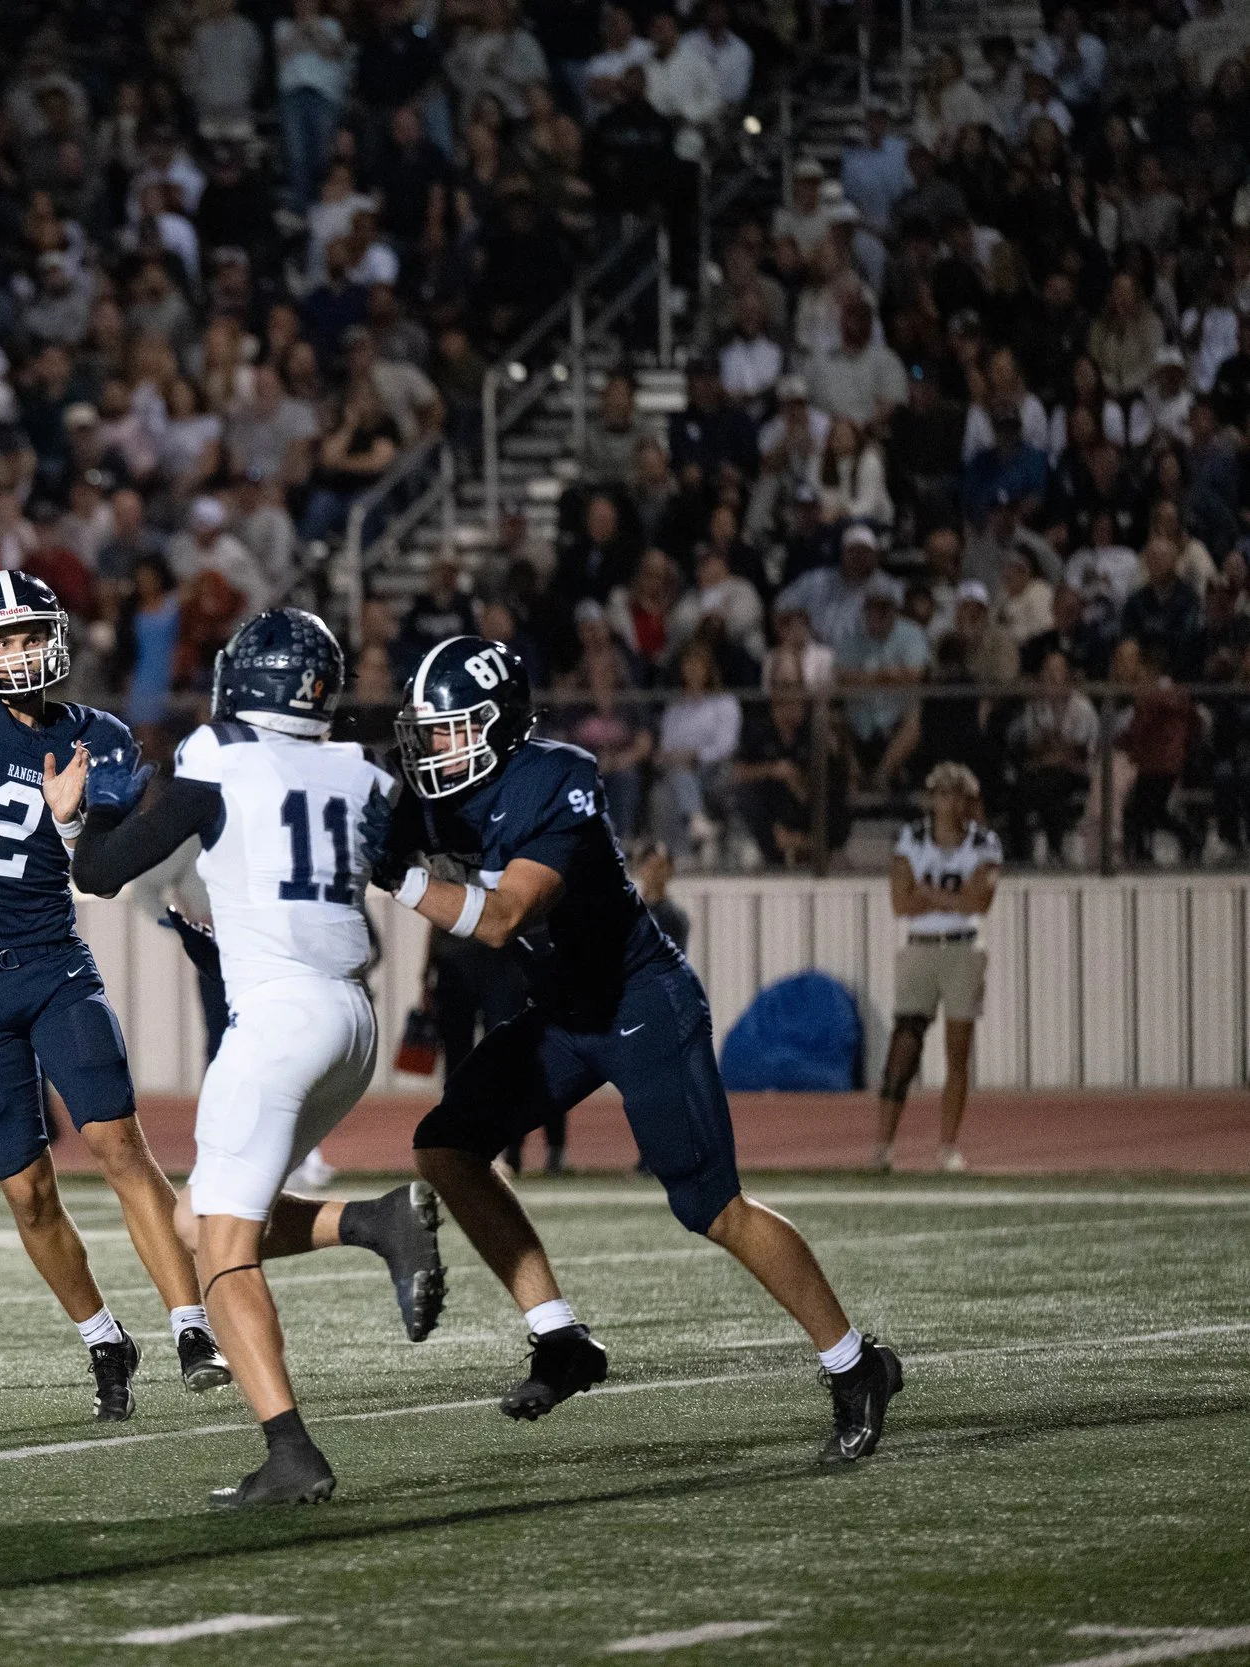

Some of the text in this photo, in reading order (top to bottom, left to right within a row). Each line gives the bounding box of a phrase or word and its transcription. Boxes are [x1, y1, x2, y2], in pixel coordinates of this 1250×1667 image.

[0, 605, 29, 617] Riddell
[464, 648, 509, 690] 87
[7, 763, 45, 787] RANGER
[279, 789, 355, 906] 11
